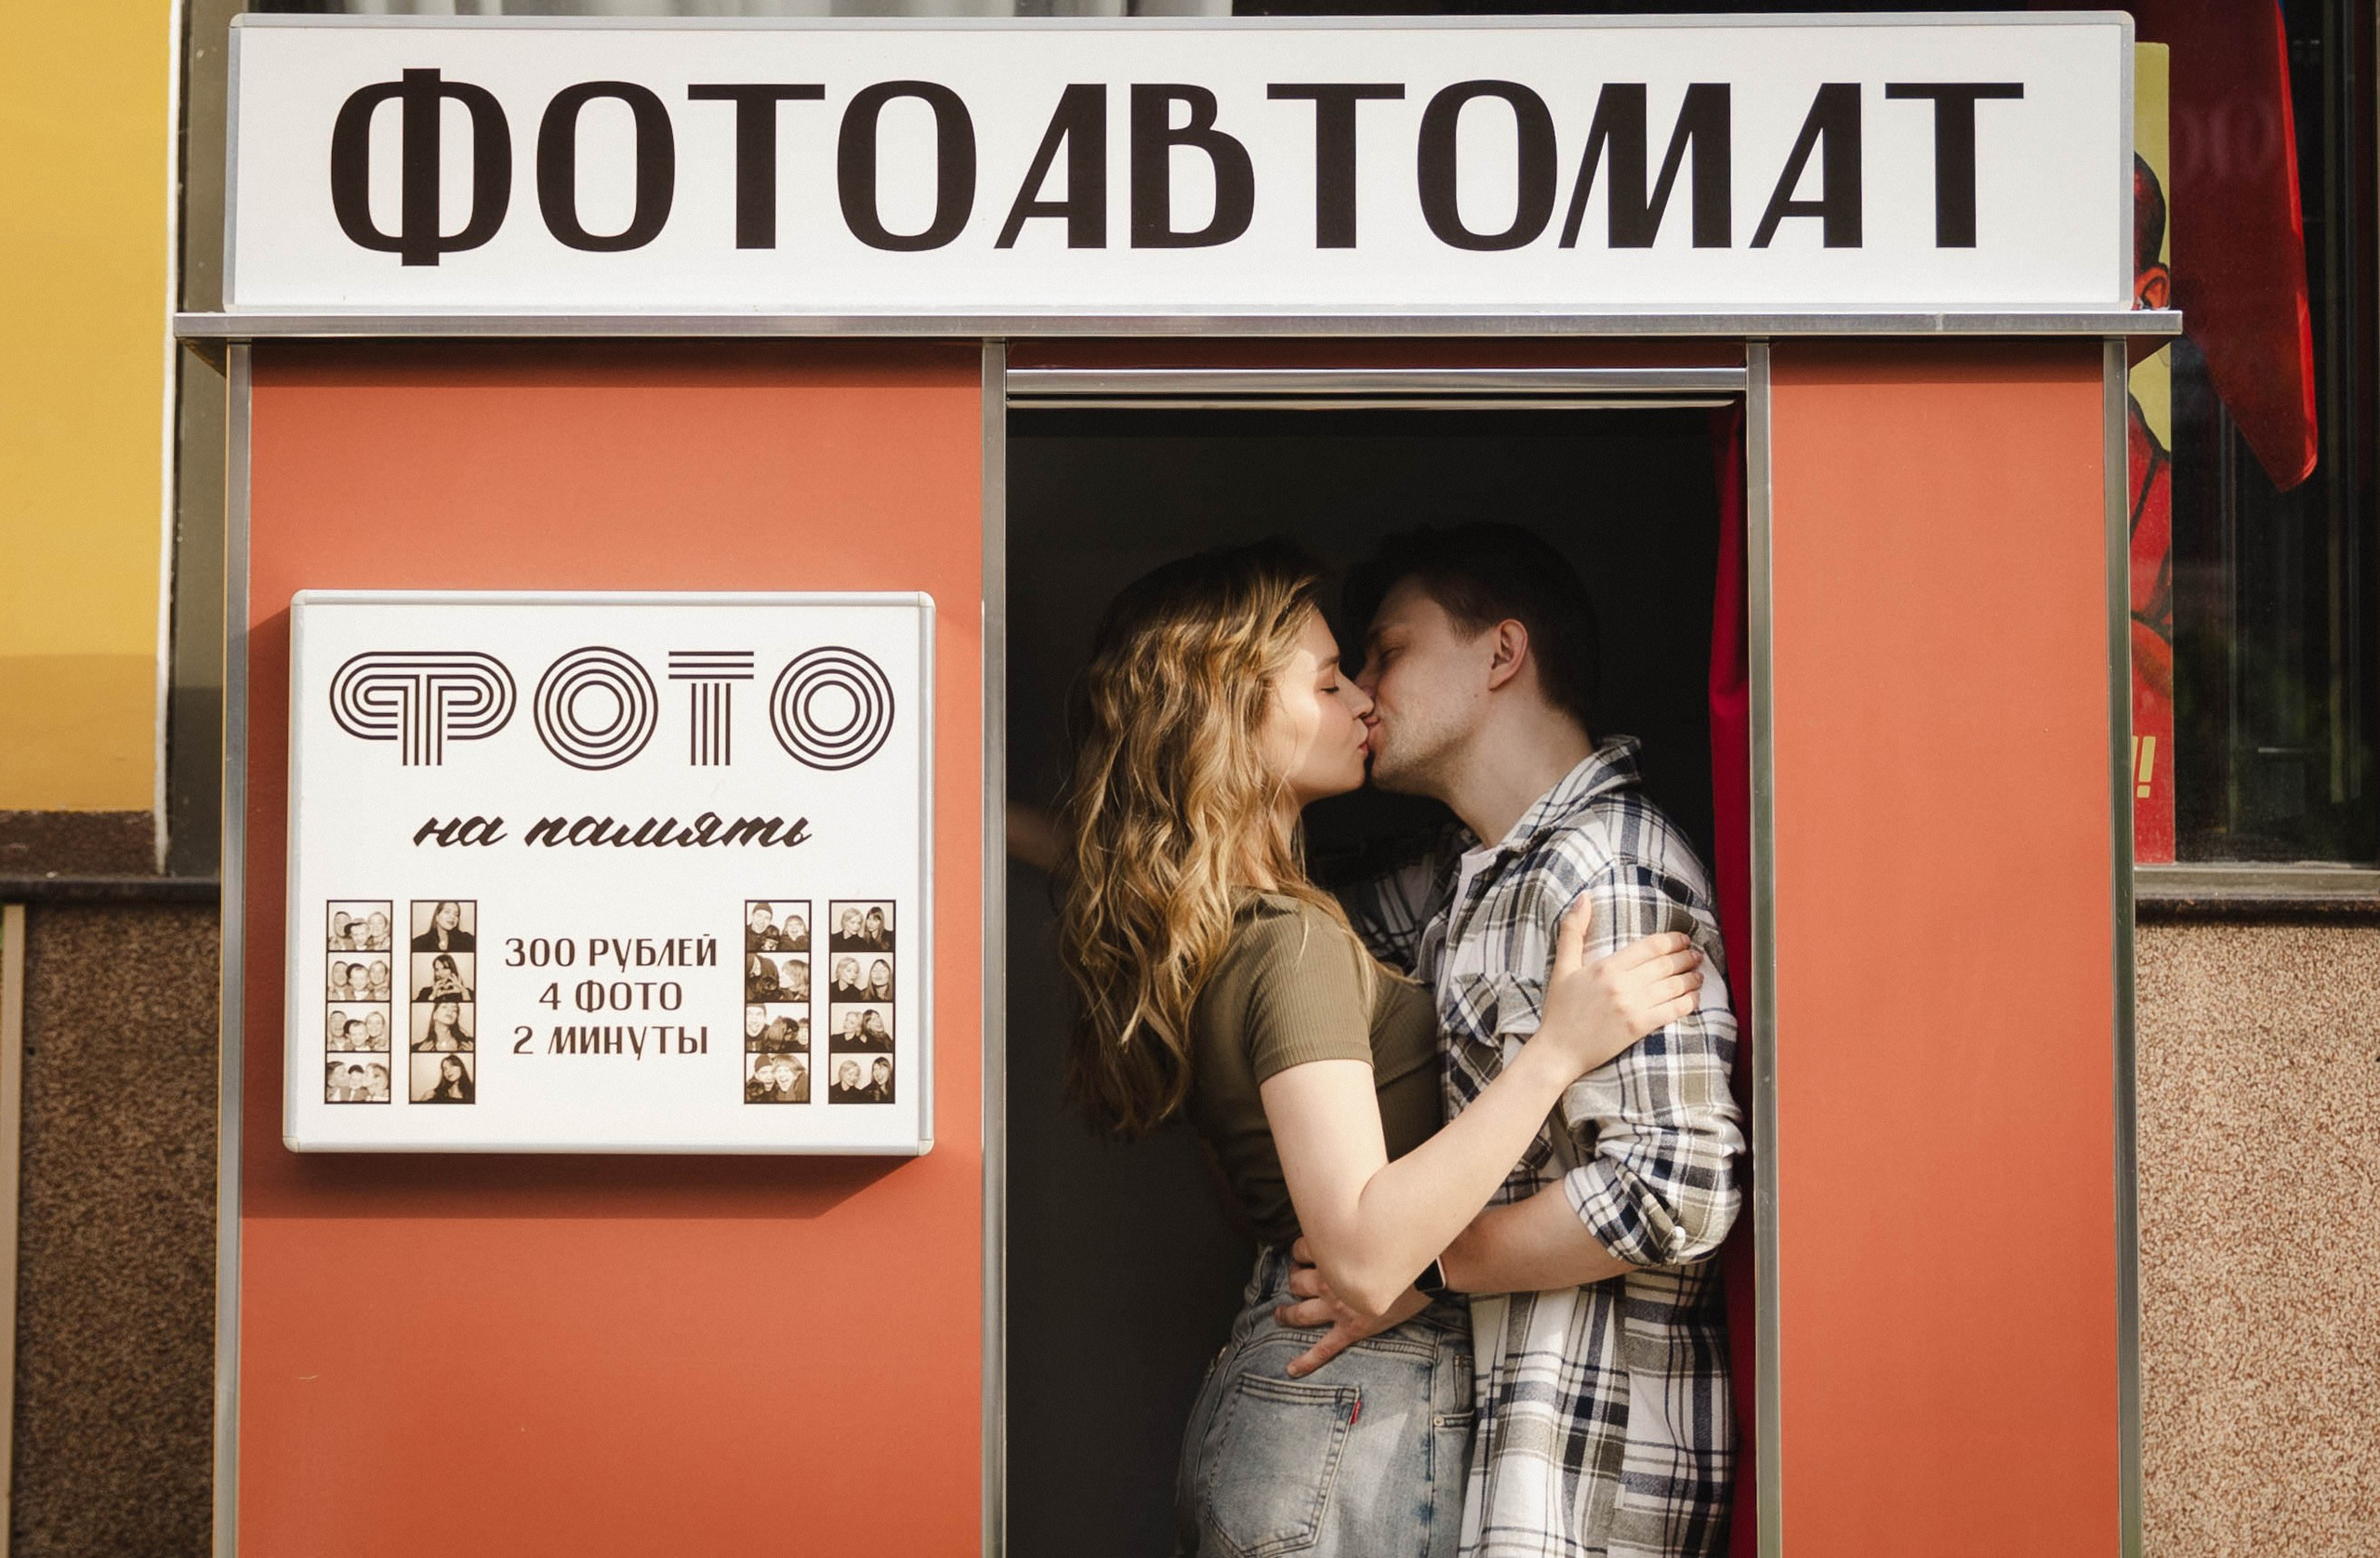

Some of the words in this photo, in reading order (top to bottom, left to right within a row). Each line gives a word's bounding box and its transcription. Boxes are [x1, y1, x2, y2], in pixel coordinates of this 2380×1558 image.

[330, 68, 2025, 267] ФОТОАВТОМАТ
[329, 645, 895, 772] ФОТО
[413, 815, 508, 848] на
[523, 812, 813, 848] память
[505, 938, 575, 967] 300
[588, 933, 717, 972] РУБЛЕЙ
[539, 983, 562, 1010] 4
[575, 980, 682, 1013] ФОТО
[512, 1025, 535, 1054] 2
[548, 1025, 708, 1060] МИНУТЫ
